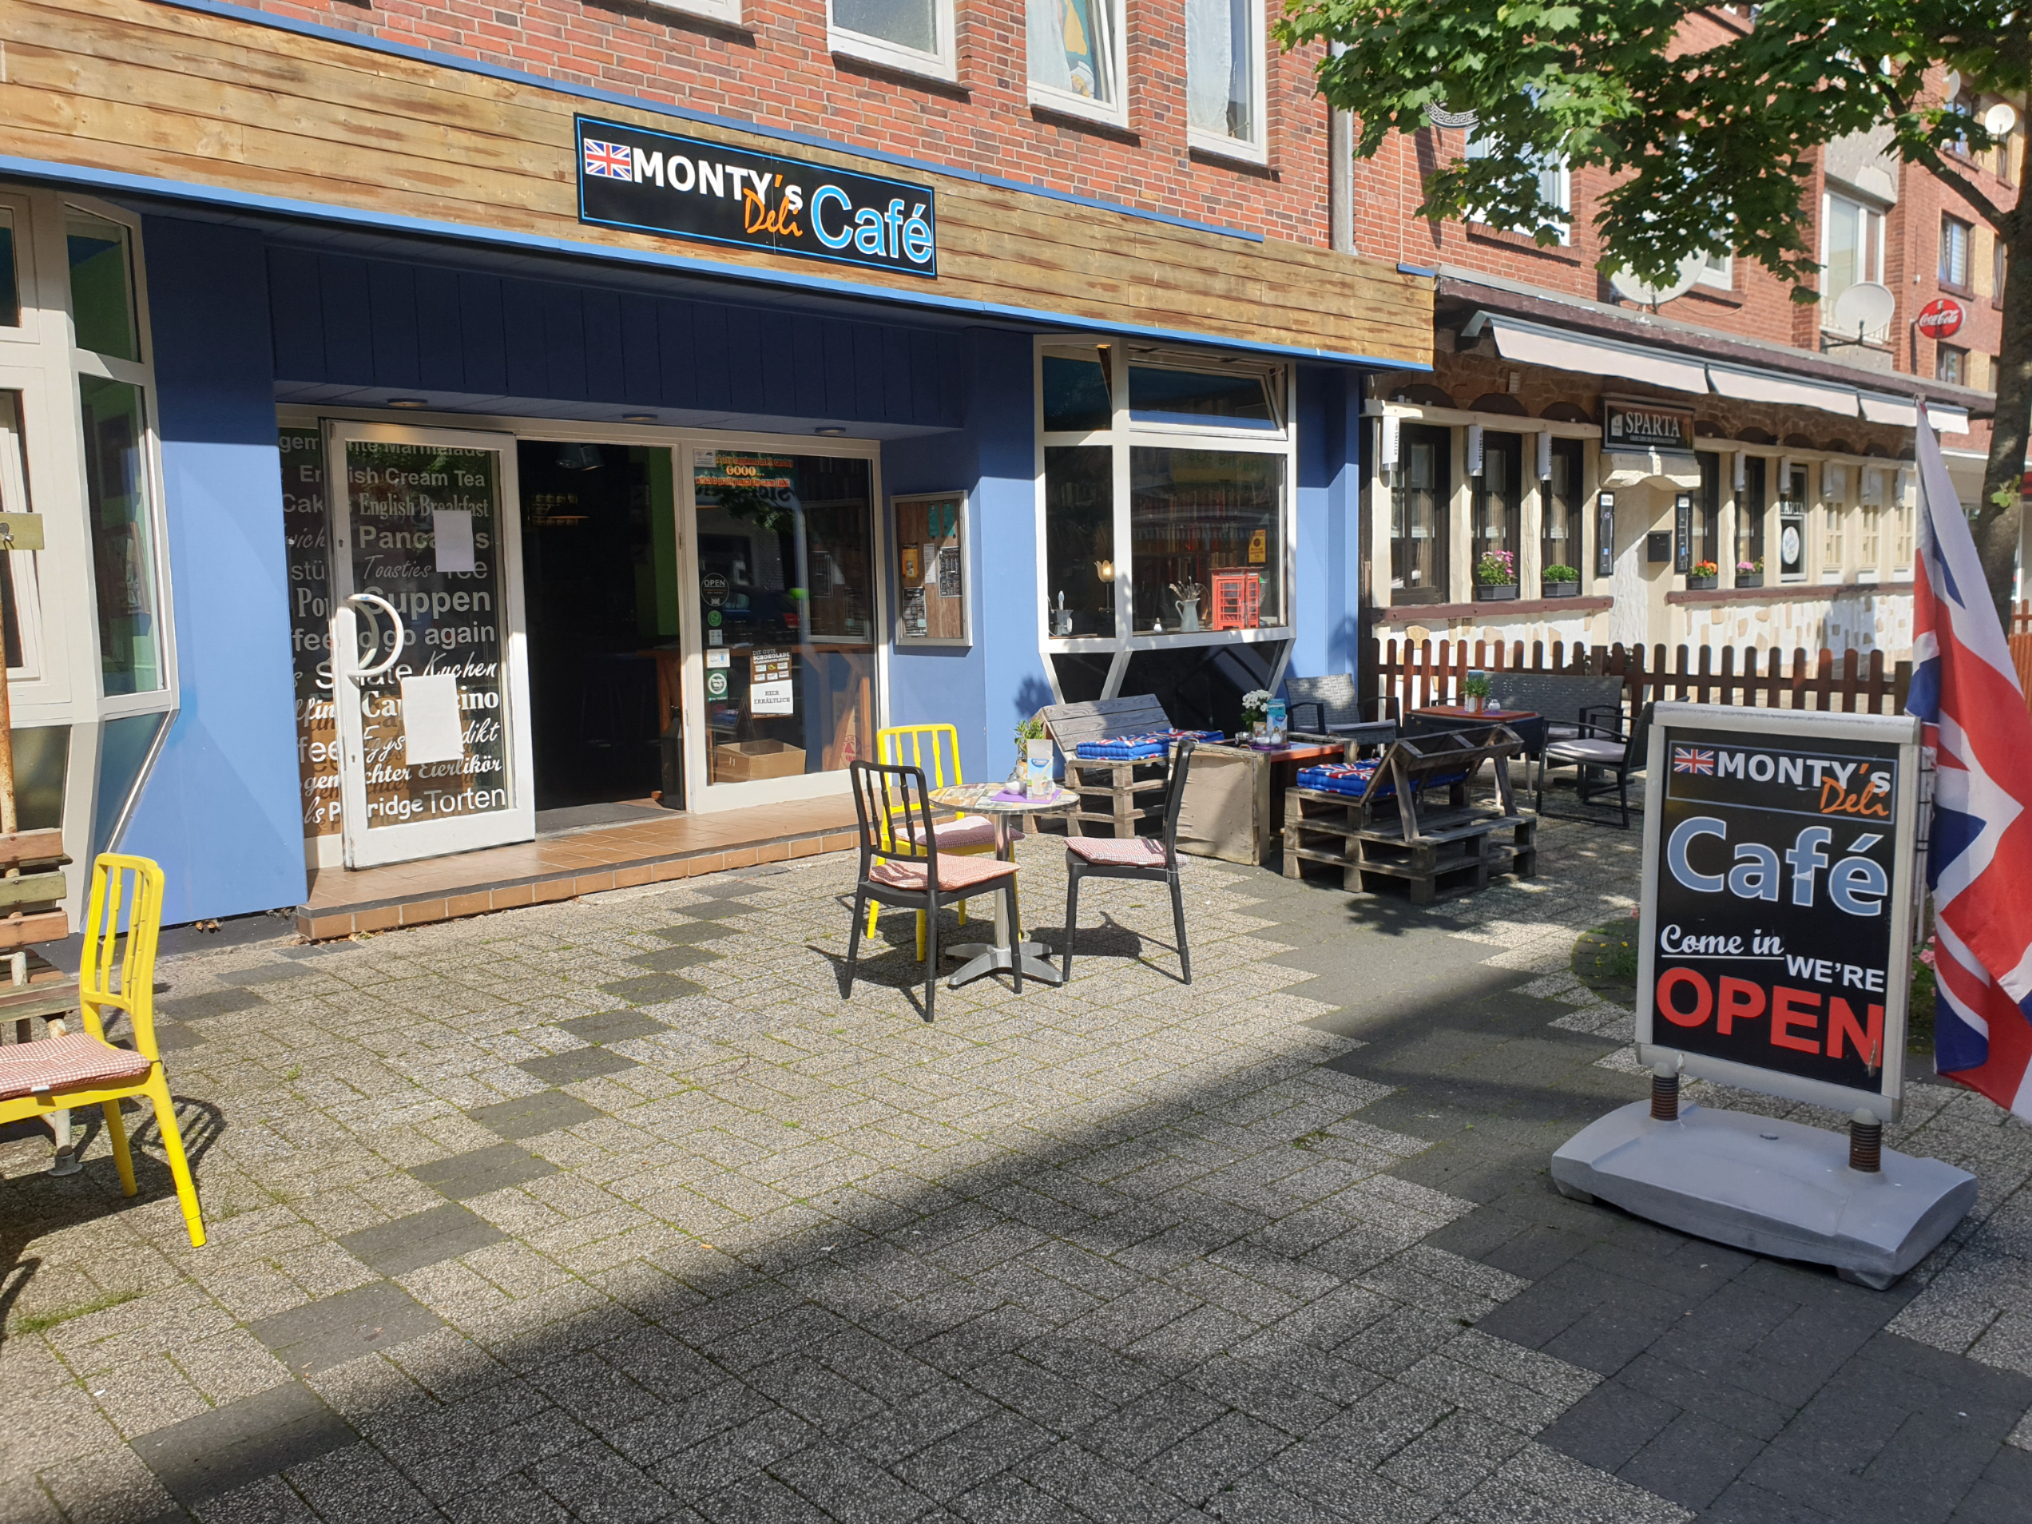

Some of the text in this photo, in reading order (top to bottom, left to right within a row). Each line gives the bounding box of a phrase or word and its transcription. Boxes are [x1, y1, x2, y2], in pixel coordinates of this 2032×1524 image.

[632, 147, 803, 211] MONTY's
[743, 187, 803, 237] Deli
[810, 184, 933, 264] Café
[1919, 310, 1960, 328] Coca-Cola
[1625, 411, 1681, 438] SPARTA
[385, 467, 448, 486] Cream
[454, 470, 485, 487] Tea
[359, 492, 415, 519] English
[419, 494, 490, 518] Breakfast
[359, 525, 490, 549] Pancas
[363, 554, 432, 580] Toasties
[703, 578, 725, 587] OPEN
[363, 586, 492, 620] Suppen
[424, 621, 495, 650] again
[423, 650, 498, 678] Kuchen
[361, 686, 499, 718] Caino
[418, 754, 502, 779] Eierlikör
[1717, 751, 1891, 794] MONTY's
[423, 787, 506, 814] Torten
[1820, 776, 1890, 817] Deli
[1666, 815, 1889, 917] Café
[1660, 924, 1785, 956] Come in
[1785, 953, 1885, 993] WE'RE
[1655, 966, 1885, 1069] OPEN
